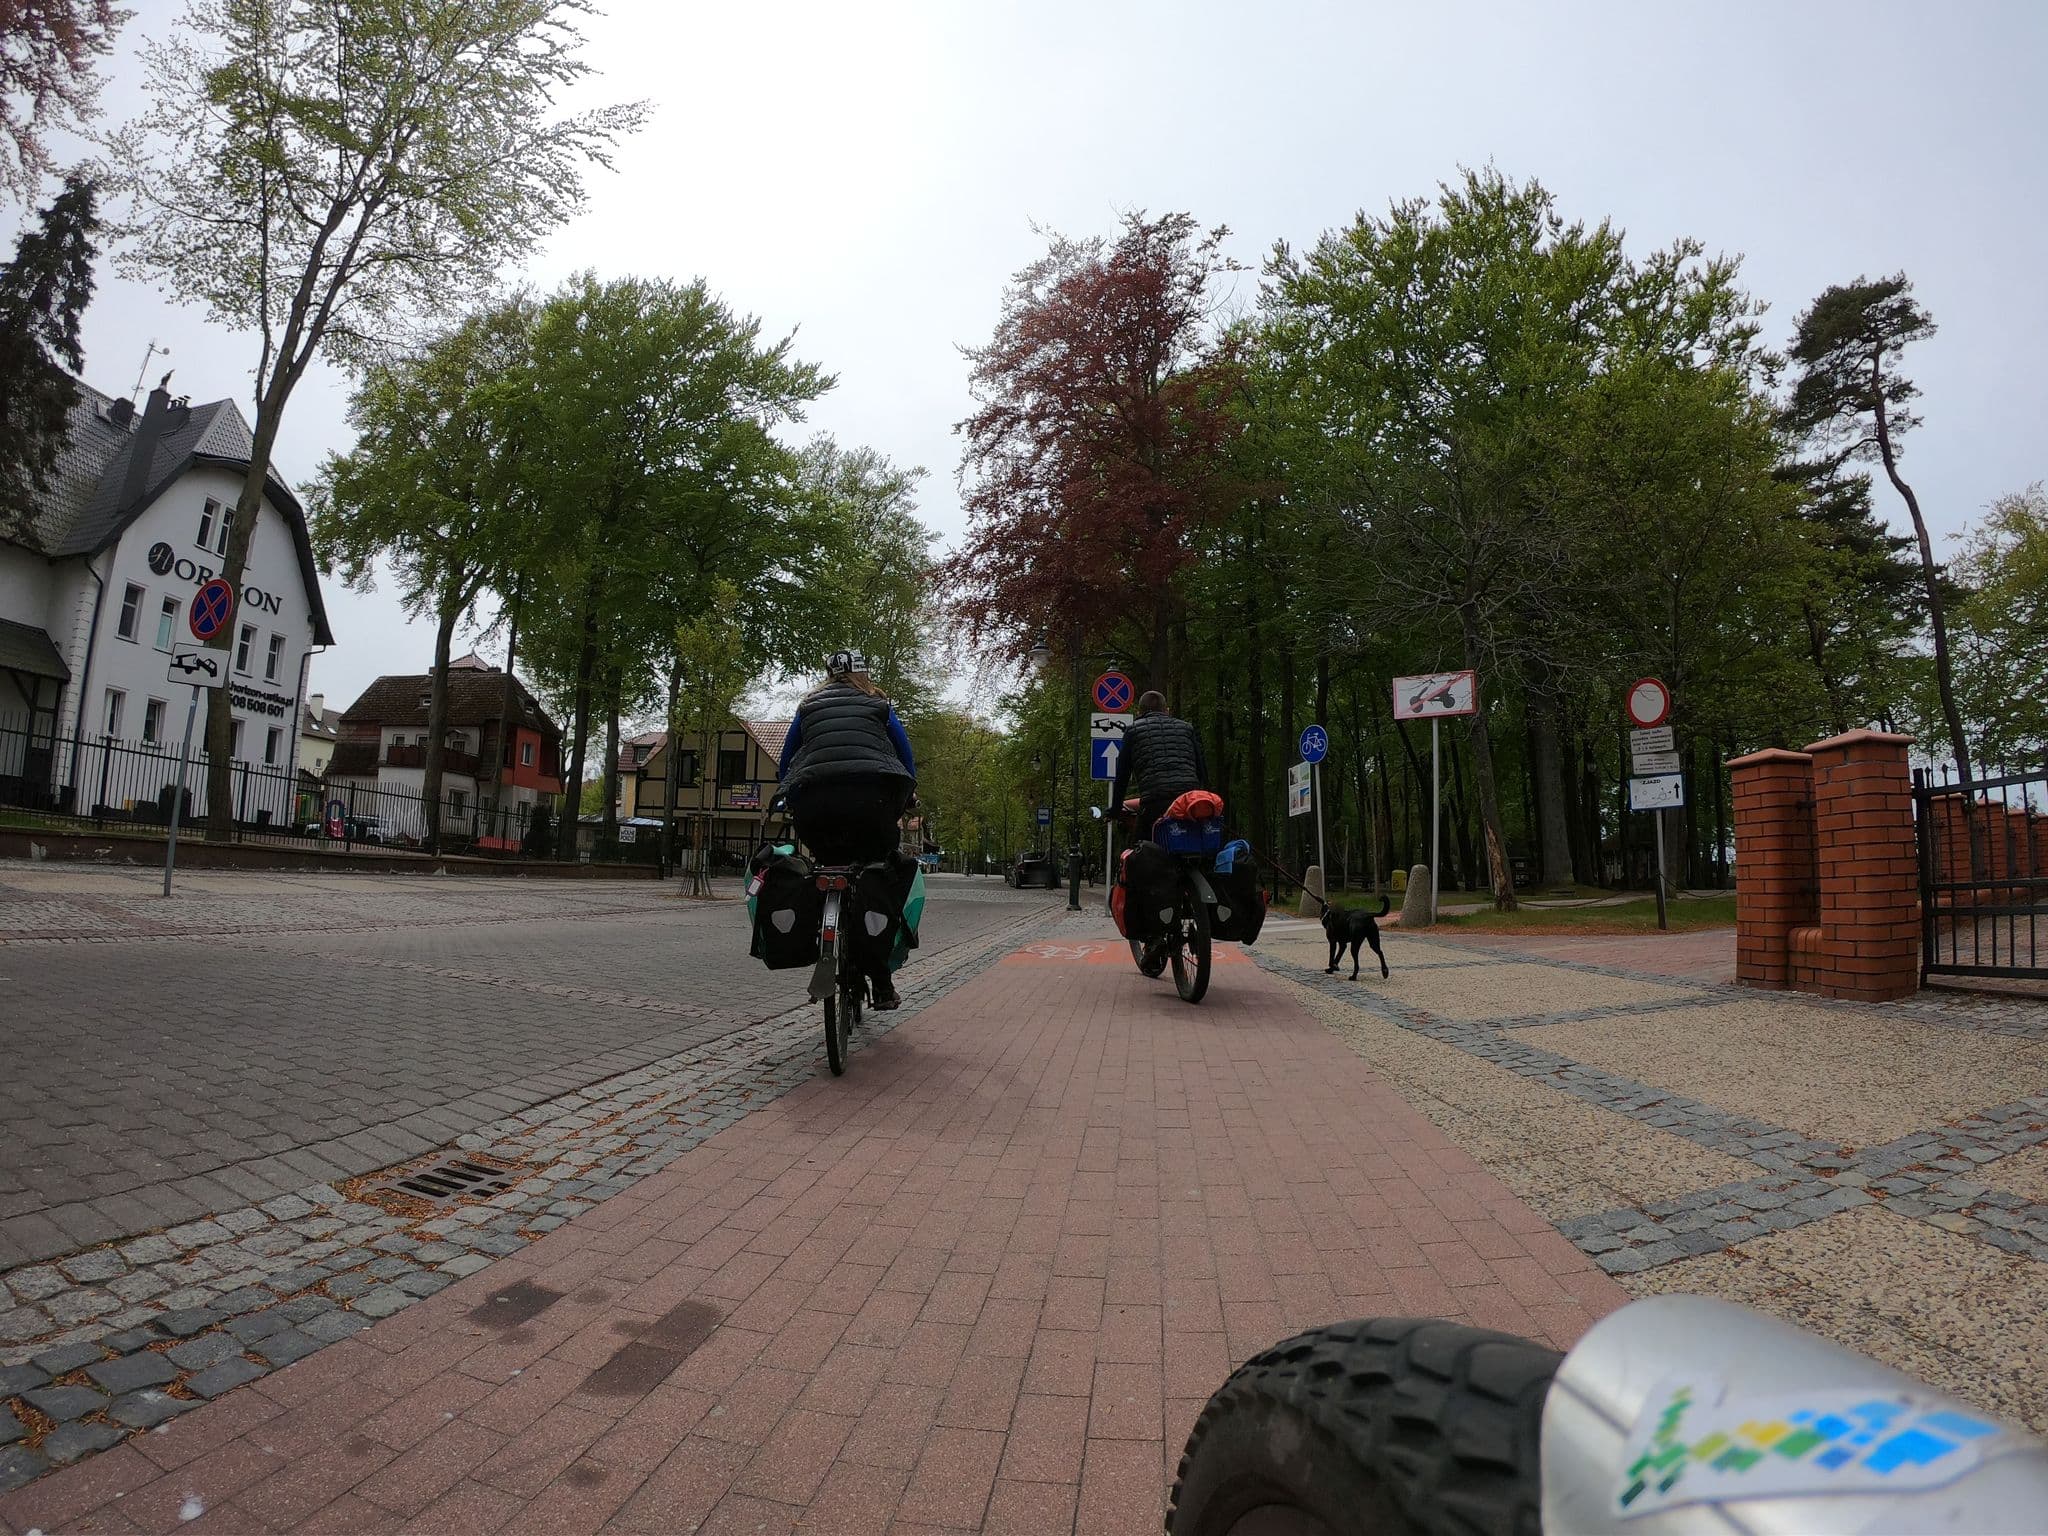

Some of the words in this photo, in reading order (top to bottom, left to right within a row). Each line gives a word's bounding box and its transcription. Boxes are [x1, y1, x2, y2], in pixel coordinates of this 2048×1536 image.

[148, 542, 283, 615] HORON
[247, 698, 266, 713] 508
[267, 703, 284, 718] 601
